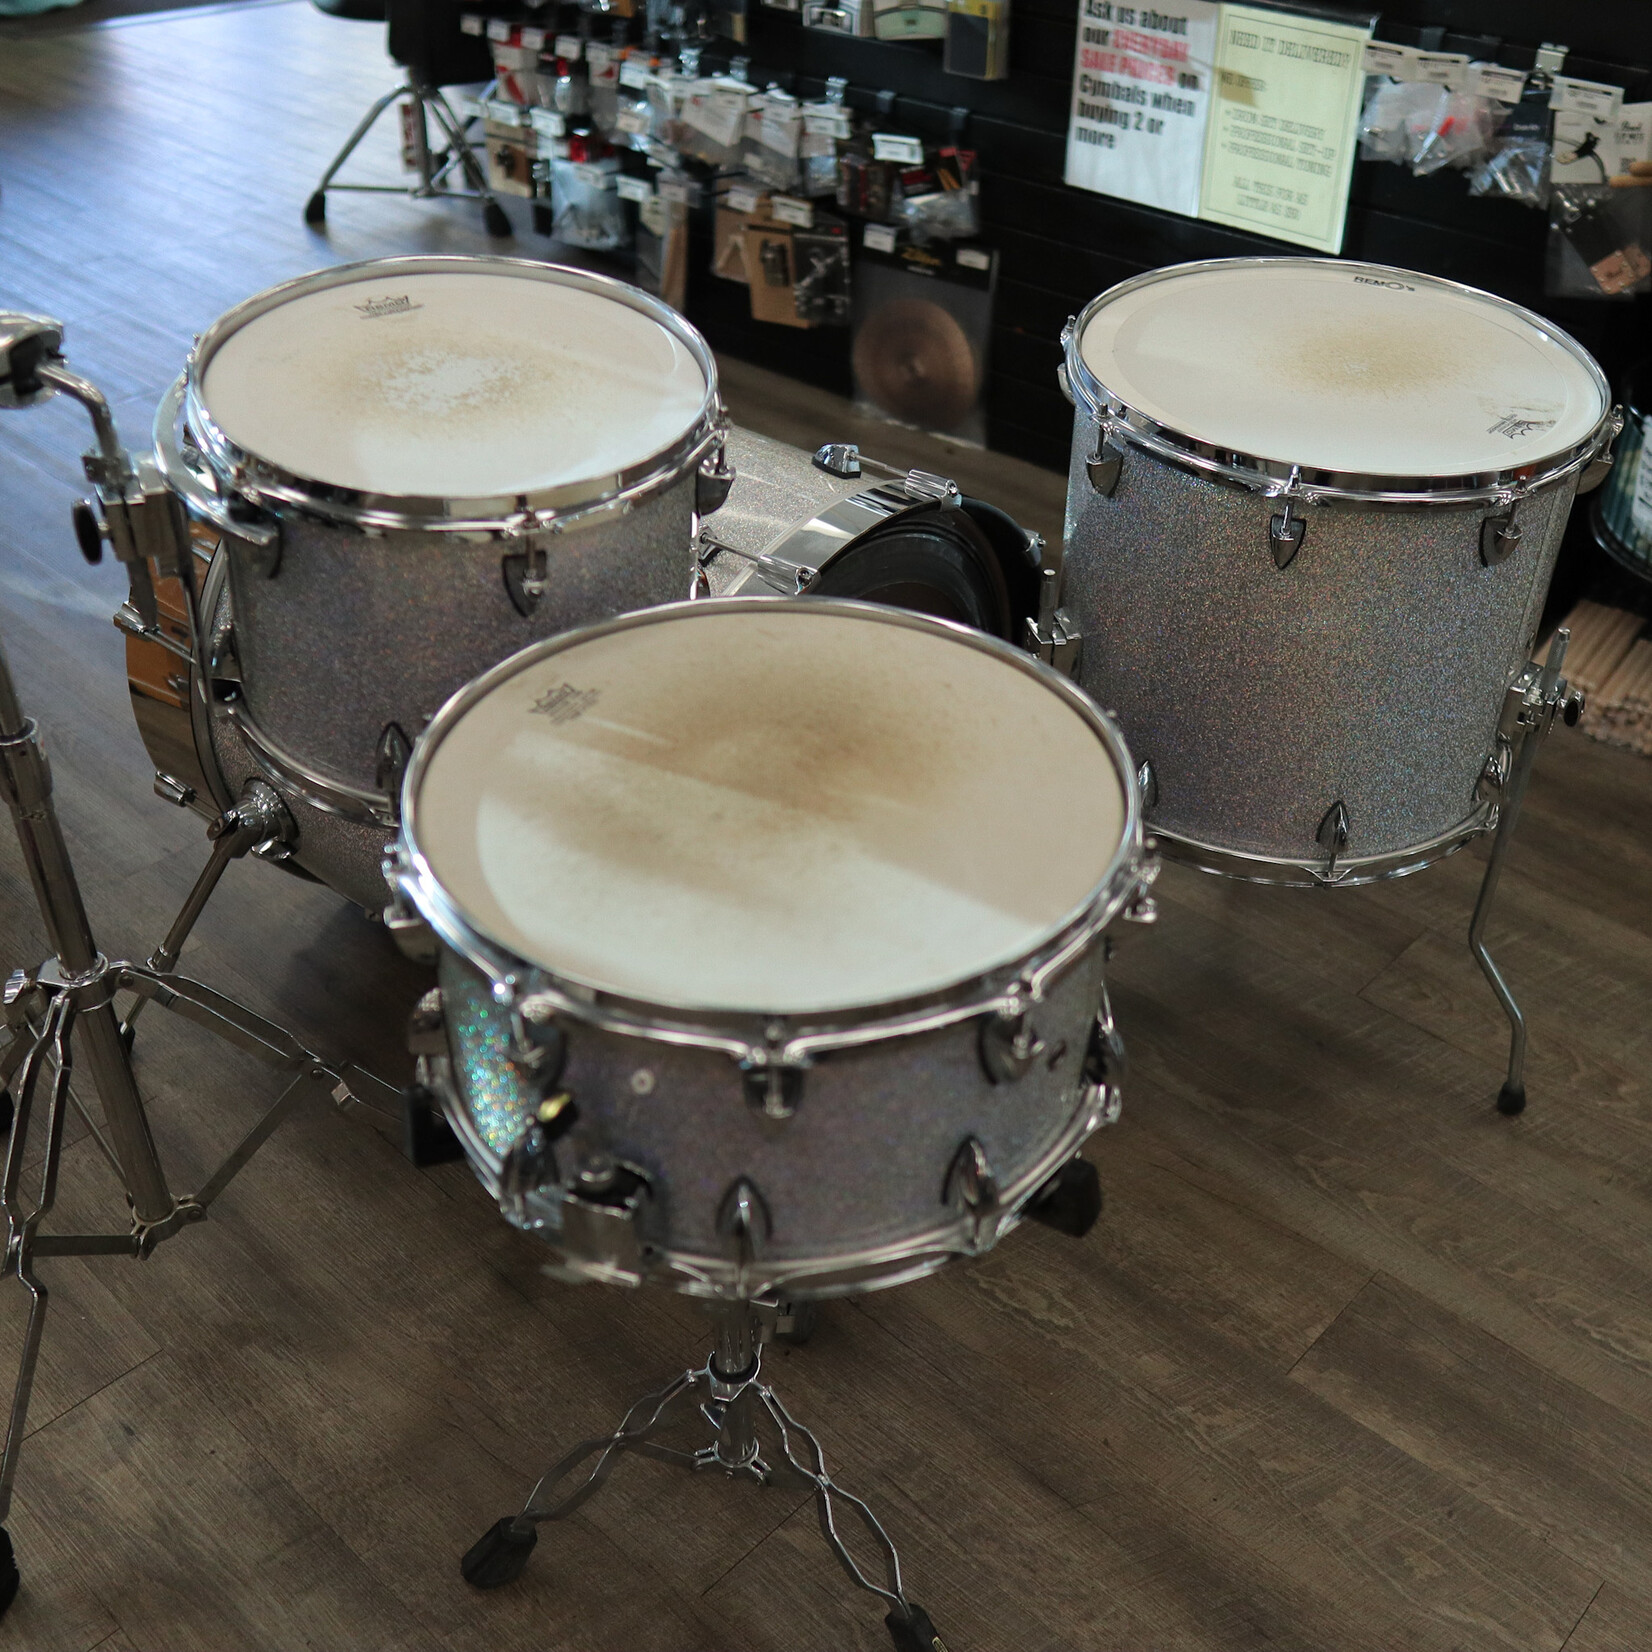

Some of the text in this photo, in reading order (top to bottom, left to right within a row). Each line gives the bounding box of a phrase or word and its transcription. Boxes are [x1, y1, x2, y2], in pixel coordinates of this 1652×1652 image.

[1086, 0, 1188, 35] Ask us about
[1084, 27, 1109, 45] our
[1230, 30, 1258, 49] NEED
[1178, 72, 1199, 89] on
[1081, 74, 1195, 117] Cymbals when
[1078, 100, 1164, 134] buying 2 or
[1076, 126, 1116, 149] more
